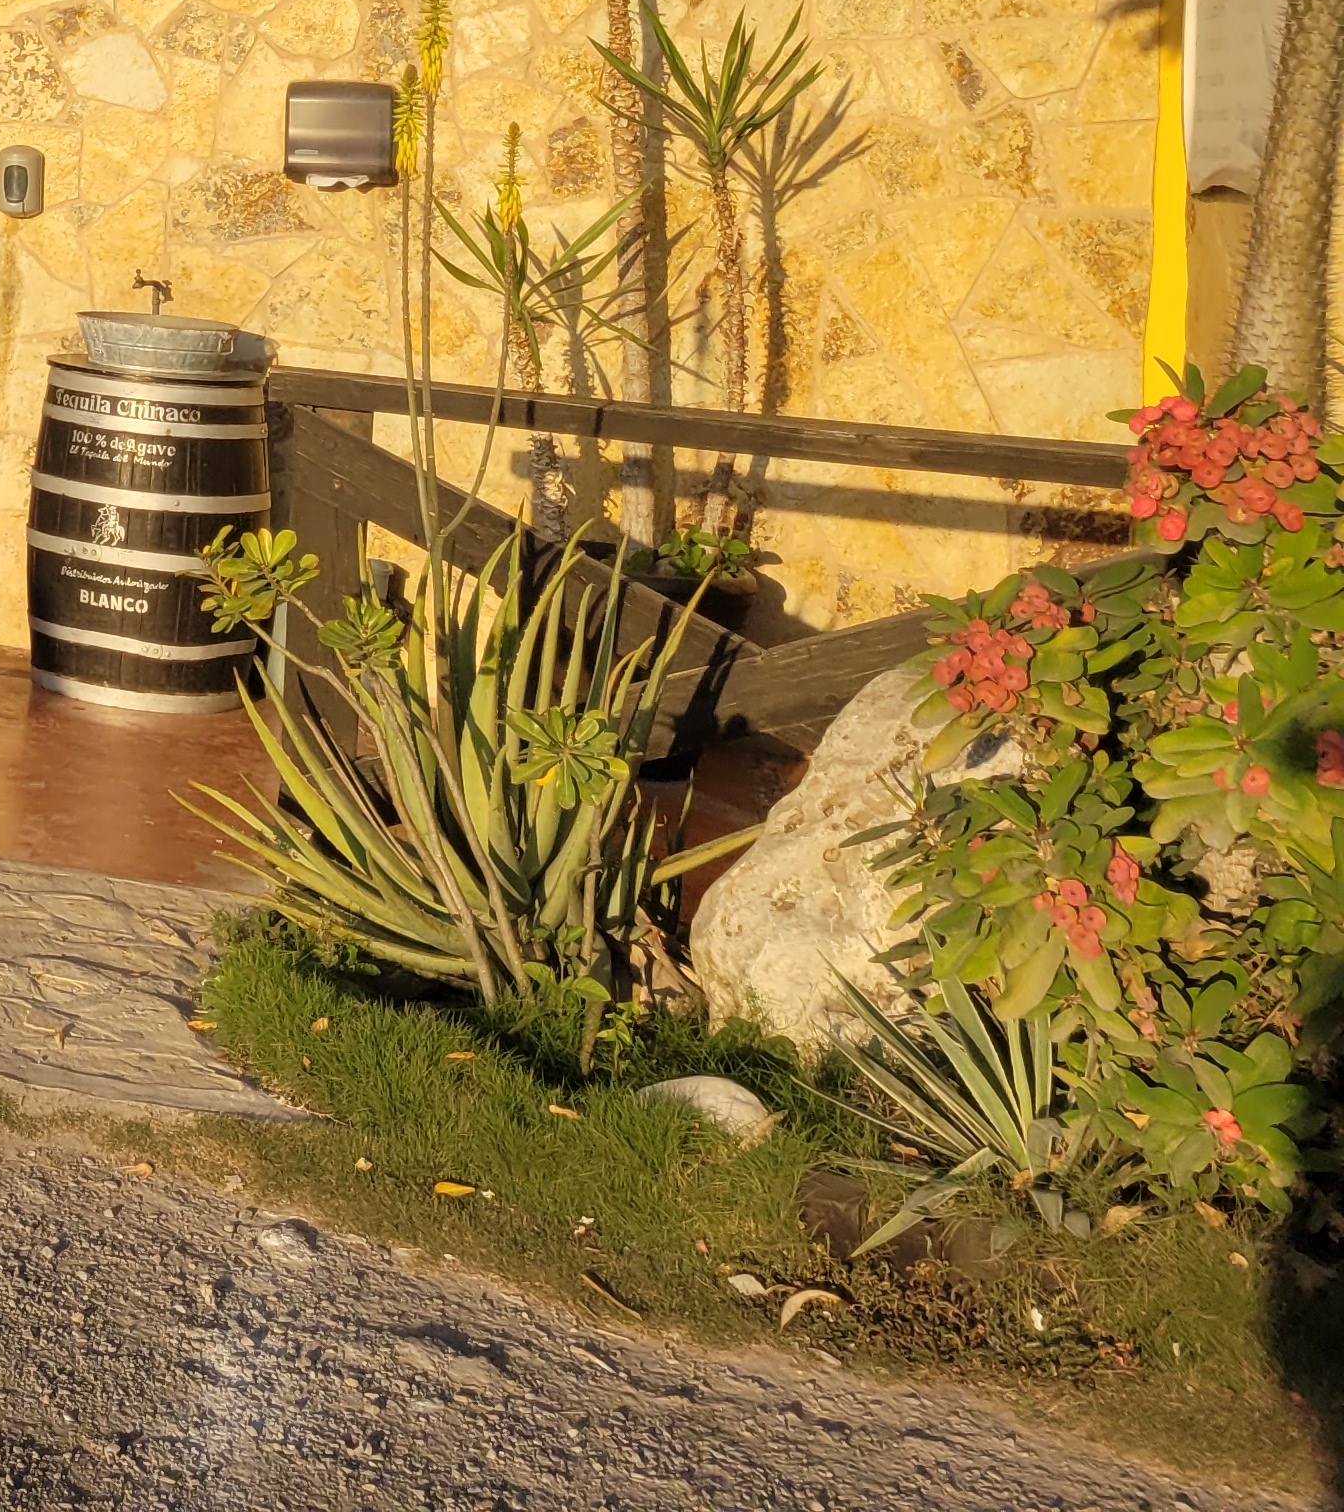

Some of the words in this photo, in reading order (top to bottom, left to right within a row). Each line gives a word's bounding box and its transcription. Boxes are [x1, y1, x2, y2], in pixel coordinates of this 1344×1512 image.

[55, 389, 111, 413] Tequila
[116, 399, 201, 422] Chinaco
[79, 588, 149, 614] BLANCO
